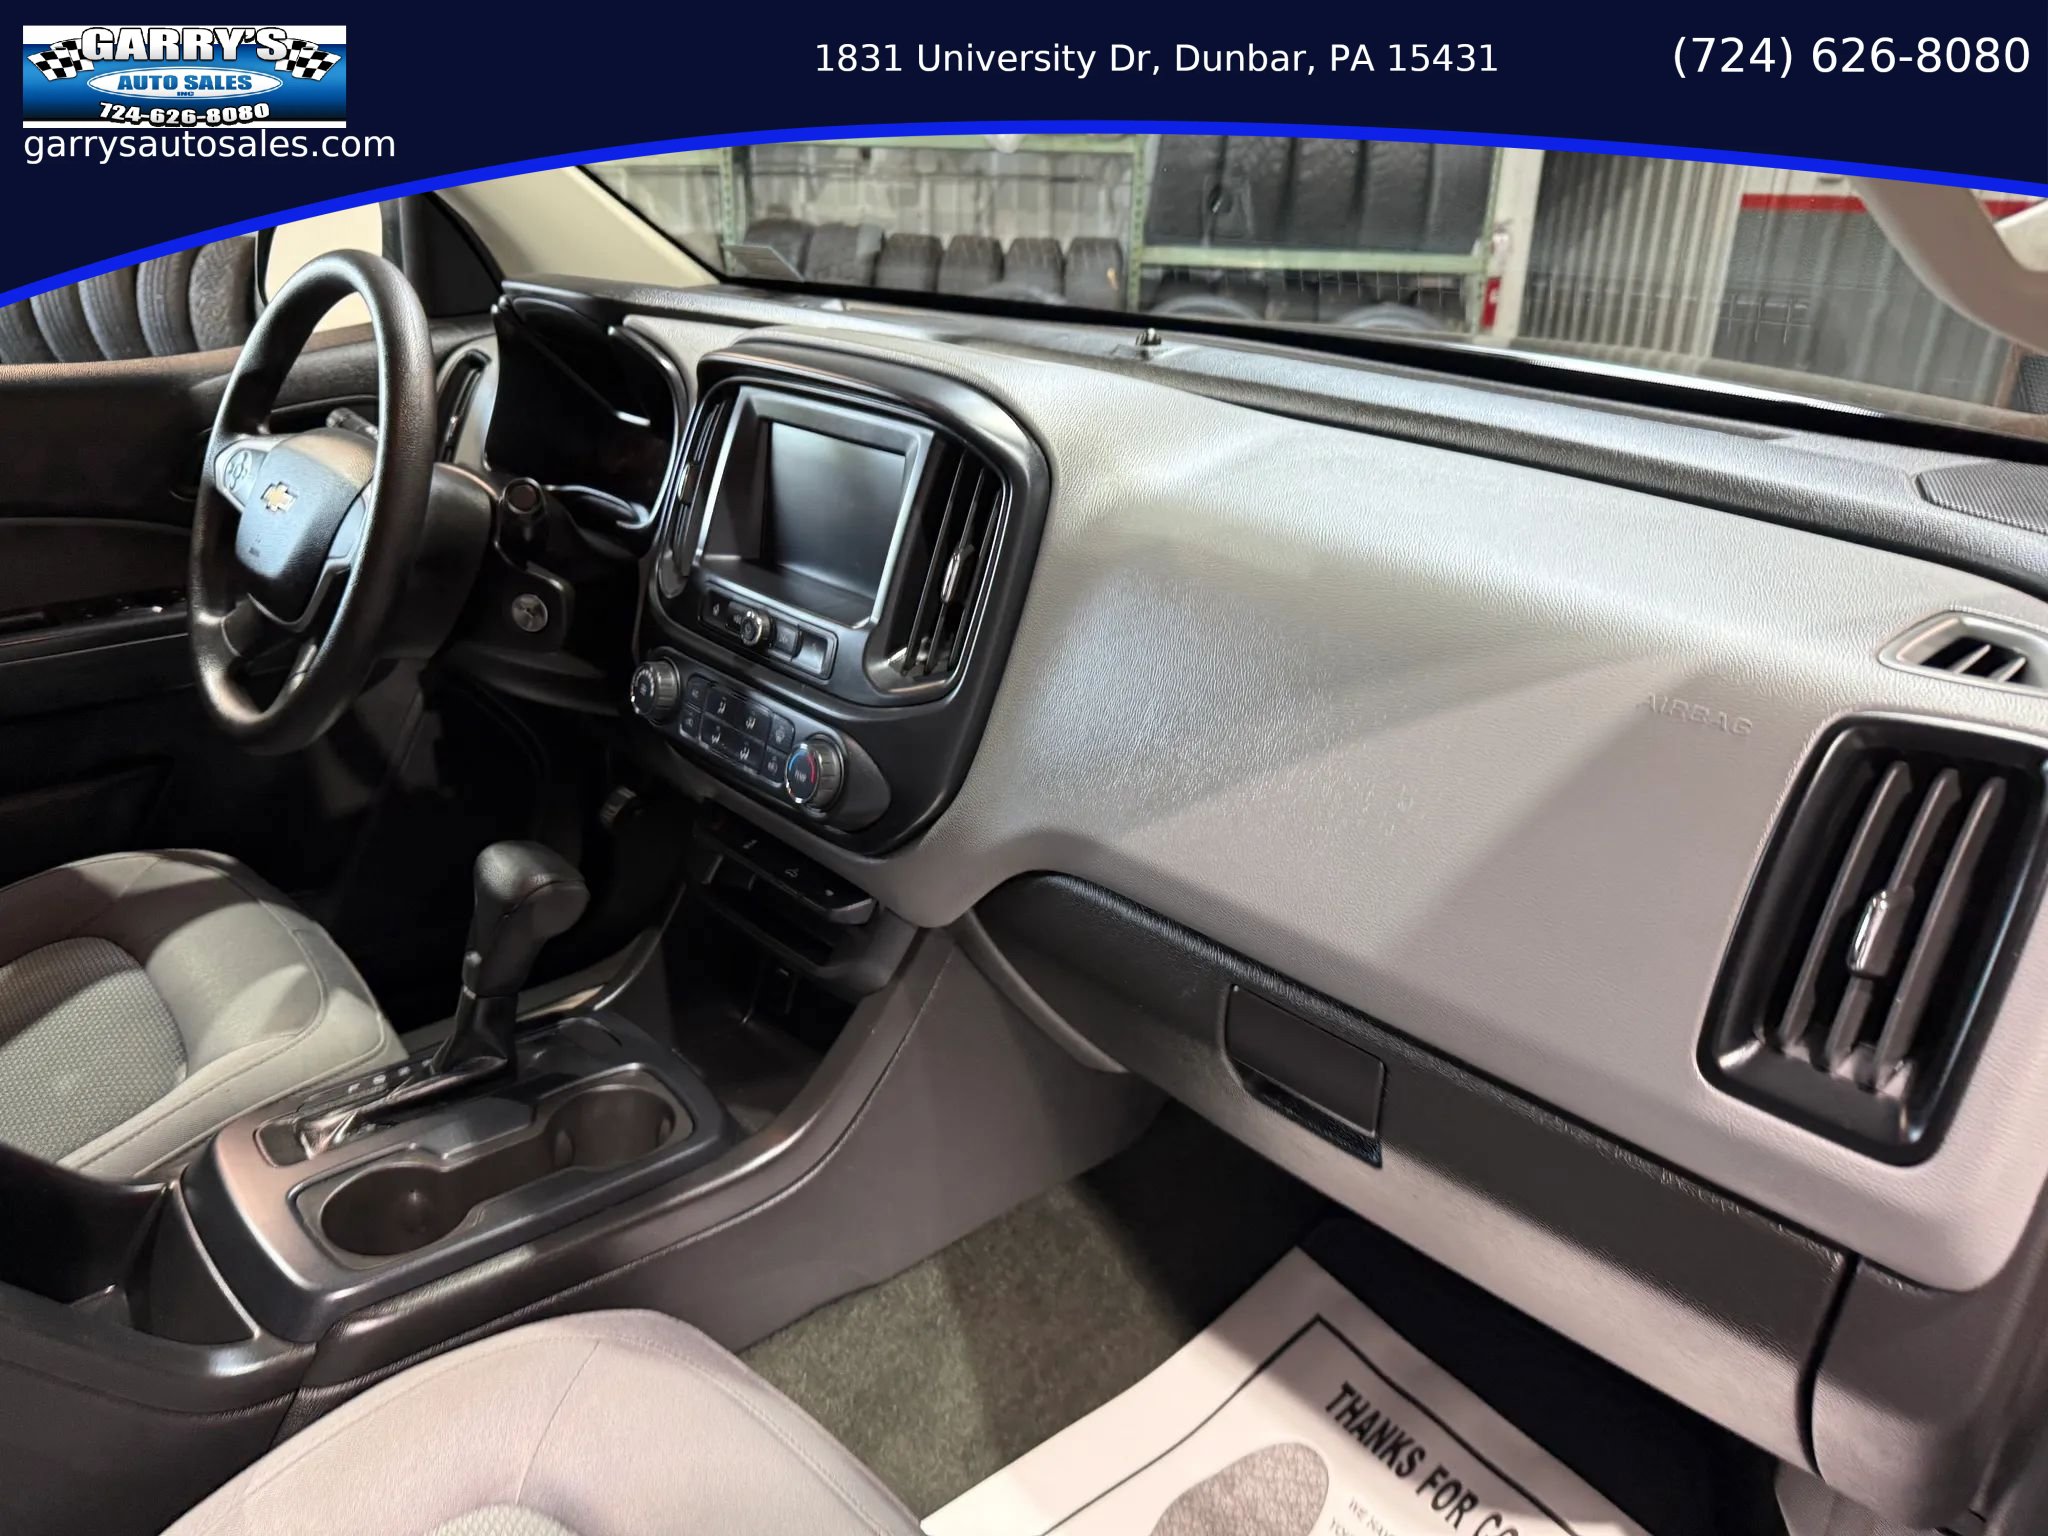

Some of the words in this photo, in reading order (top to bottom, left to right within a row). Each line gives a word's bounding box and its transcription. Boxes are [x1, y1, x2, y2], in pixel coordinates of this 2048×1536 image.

[1635, 691, 1753, 737] AIRBAG
[1326, 1380, 1427, 1479] THANKS
[1415, 1463, 1480, 1530] FOR
